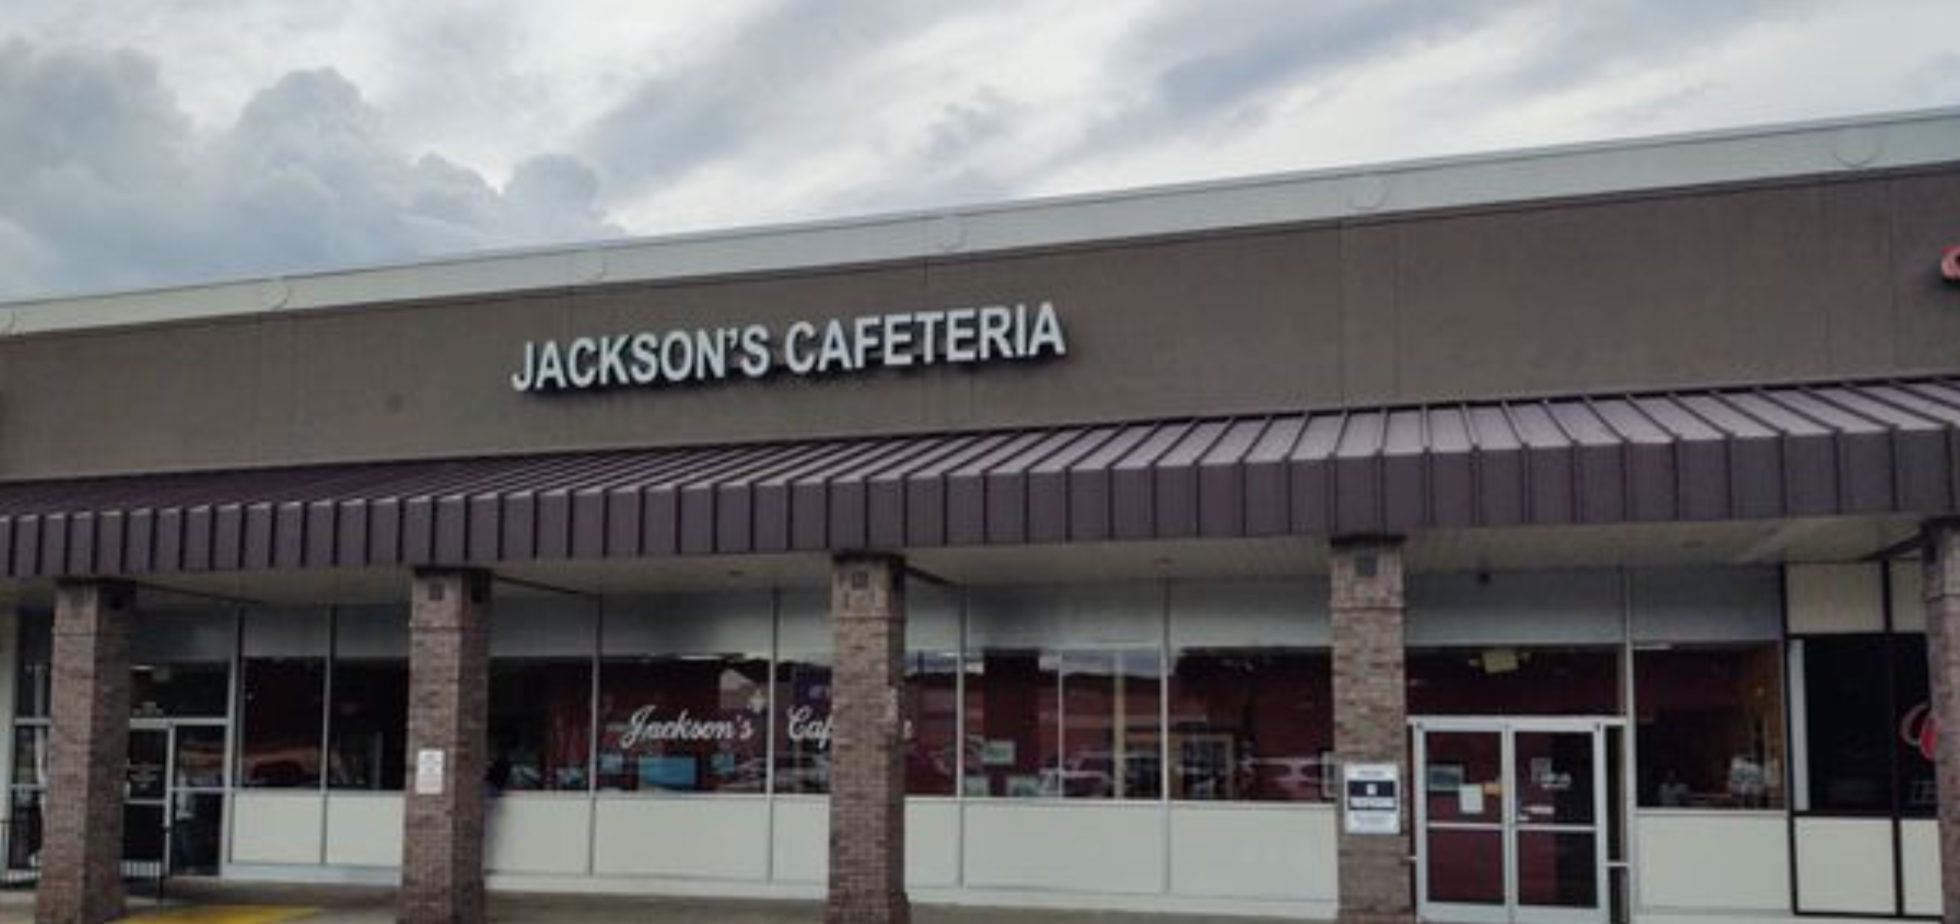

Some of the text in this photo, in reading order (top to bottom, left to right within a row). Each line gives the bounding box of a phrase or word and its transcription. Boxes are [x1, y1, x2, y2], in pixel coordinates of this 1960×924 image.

[511, 301, 1066, 391] JACKSON'S CAFETERIA
[620, 704, 752, 749] Jackson's
